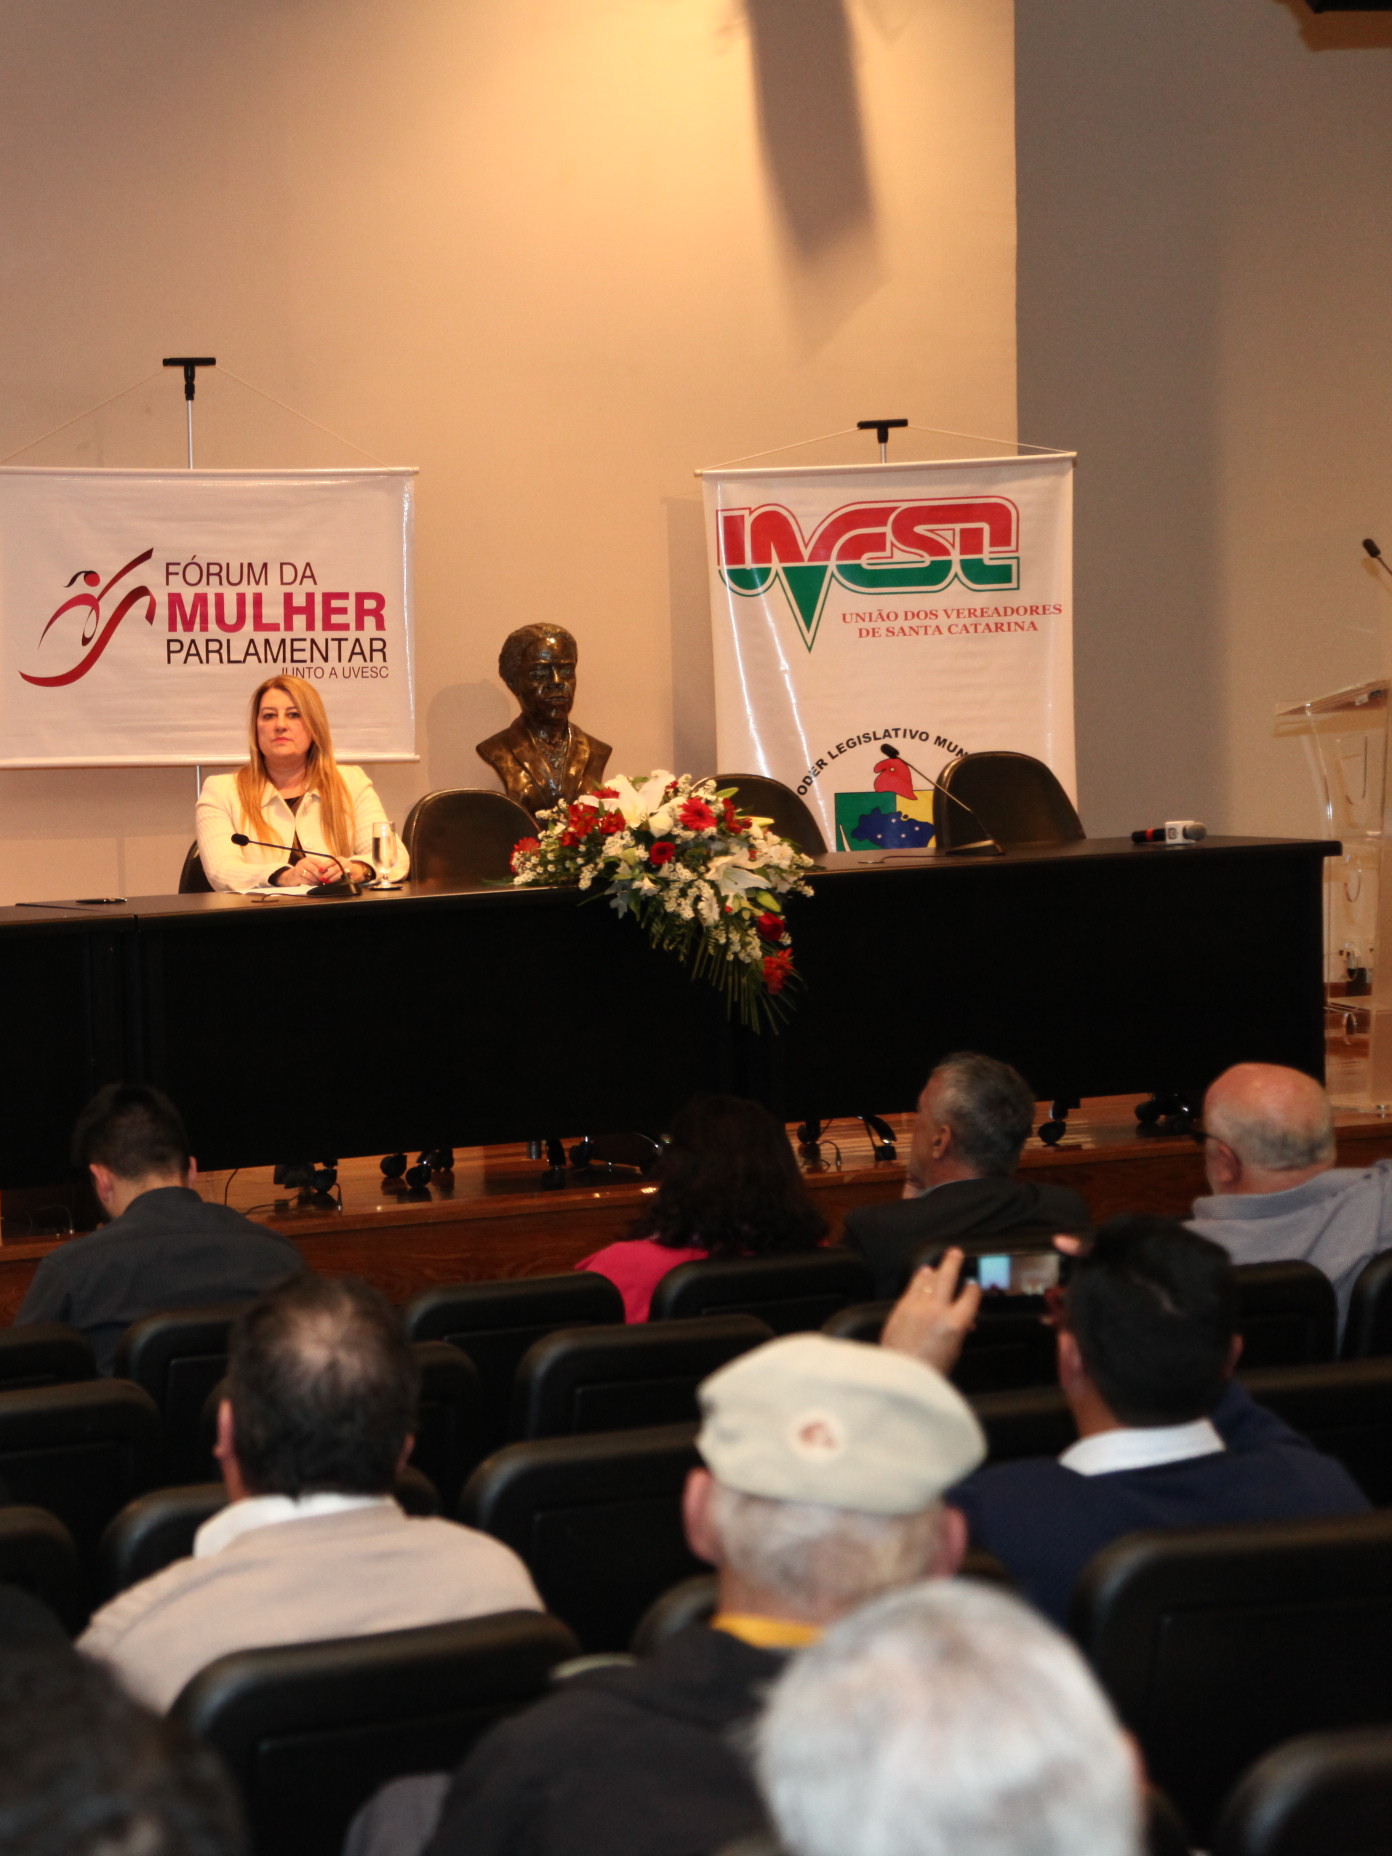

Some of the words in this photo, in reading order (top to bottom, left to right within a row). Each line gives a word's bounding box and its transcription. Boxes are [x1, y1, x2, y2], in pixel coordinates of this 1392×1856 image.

[165, 554, 269, 587] FÓRUM
[279, 562, 318, 586] DA
[166, 591, 386, 633] MULHER
[841, 609, 899, 624] UNIÃO
[903, 609, 939, 622] DOS
[942, 604, 1063, 620] VEREADORES
[858, 627, 882, 639] DE
[885, 624, 943, 638] SANTA
[948, 620, 1039, 635] CATARINA
[166, 637, 387, 664] PARLAMENTAR
[281, 666, 325, 679] JUNTO
[329, 666, 338, 679] A
[342, 666, 389, 679] UVESC
[796, 758, 829, 796] ODER
[827, 727, 930, 760] LEGISLATIVO
